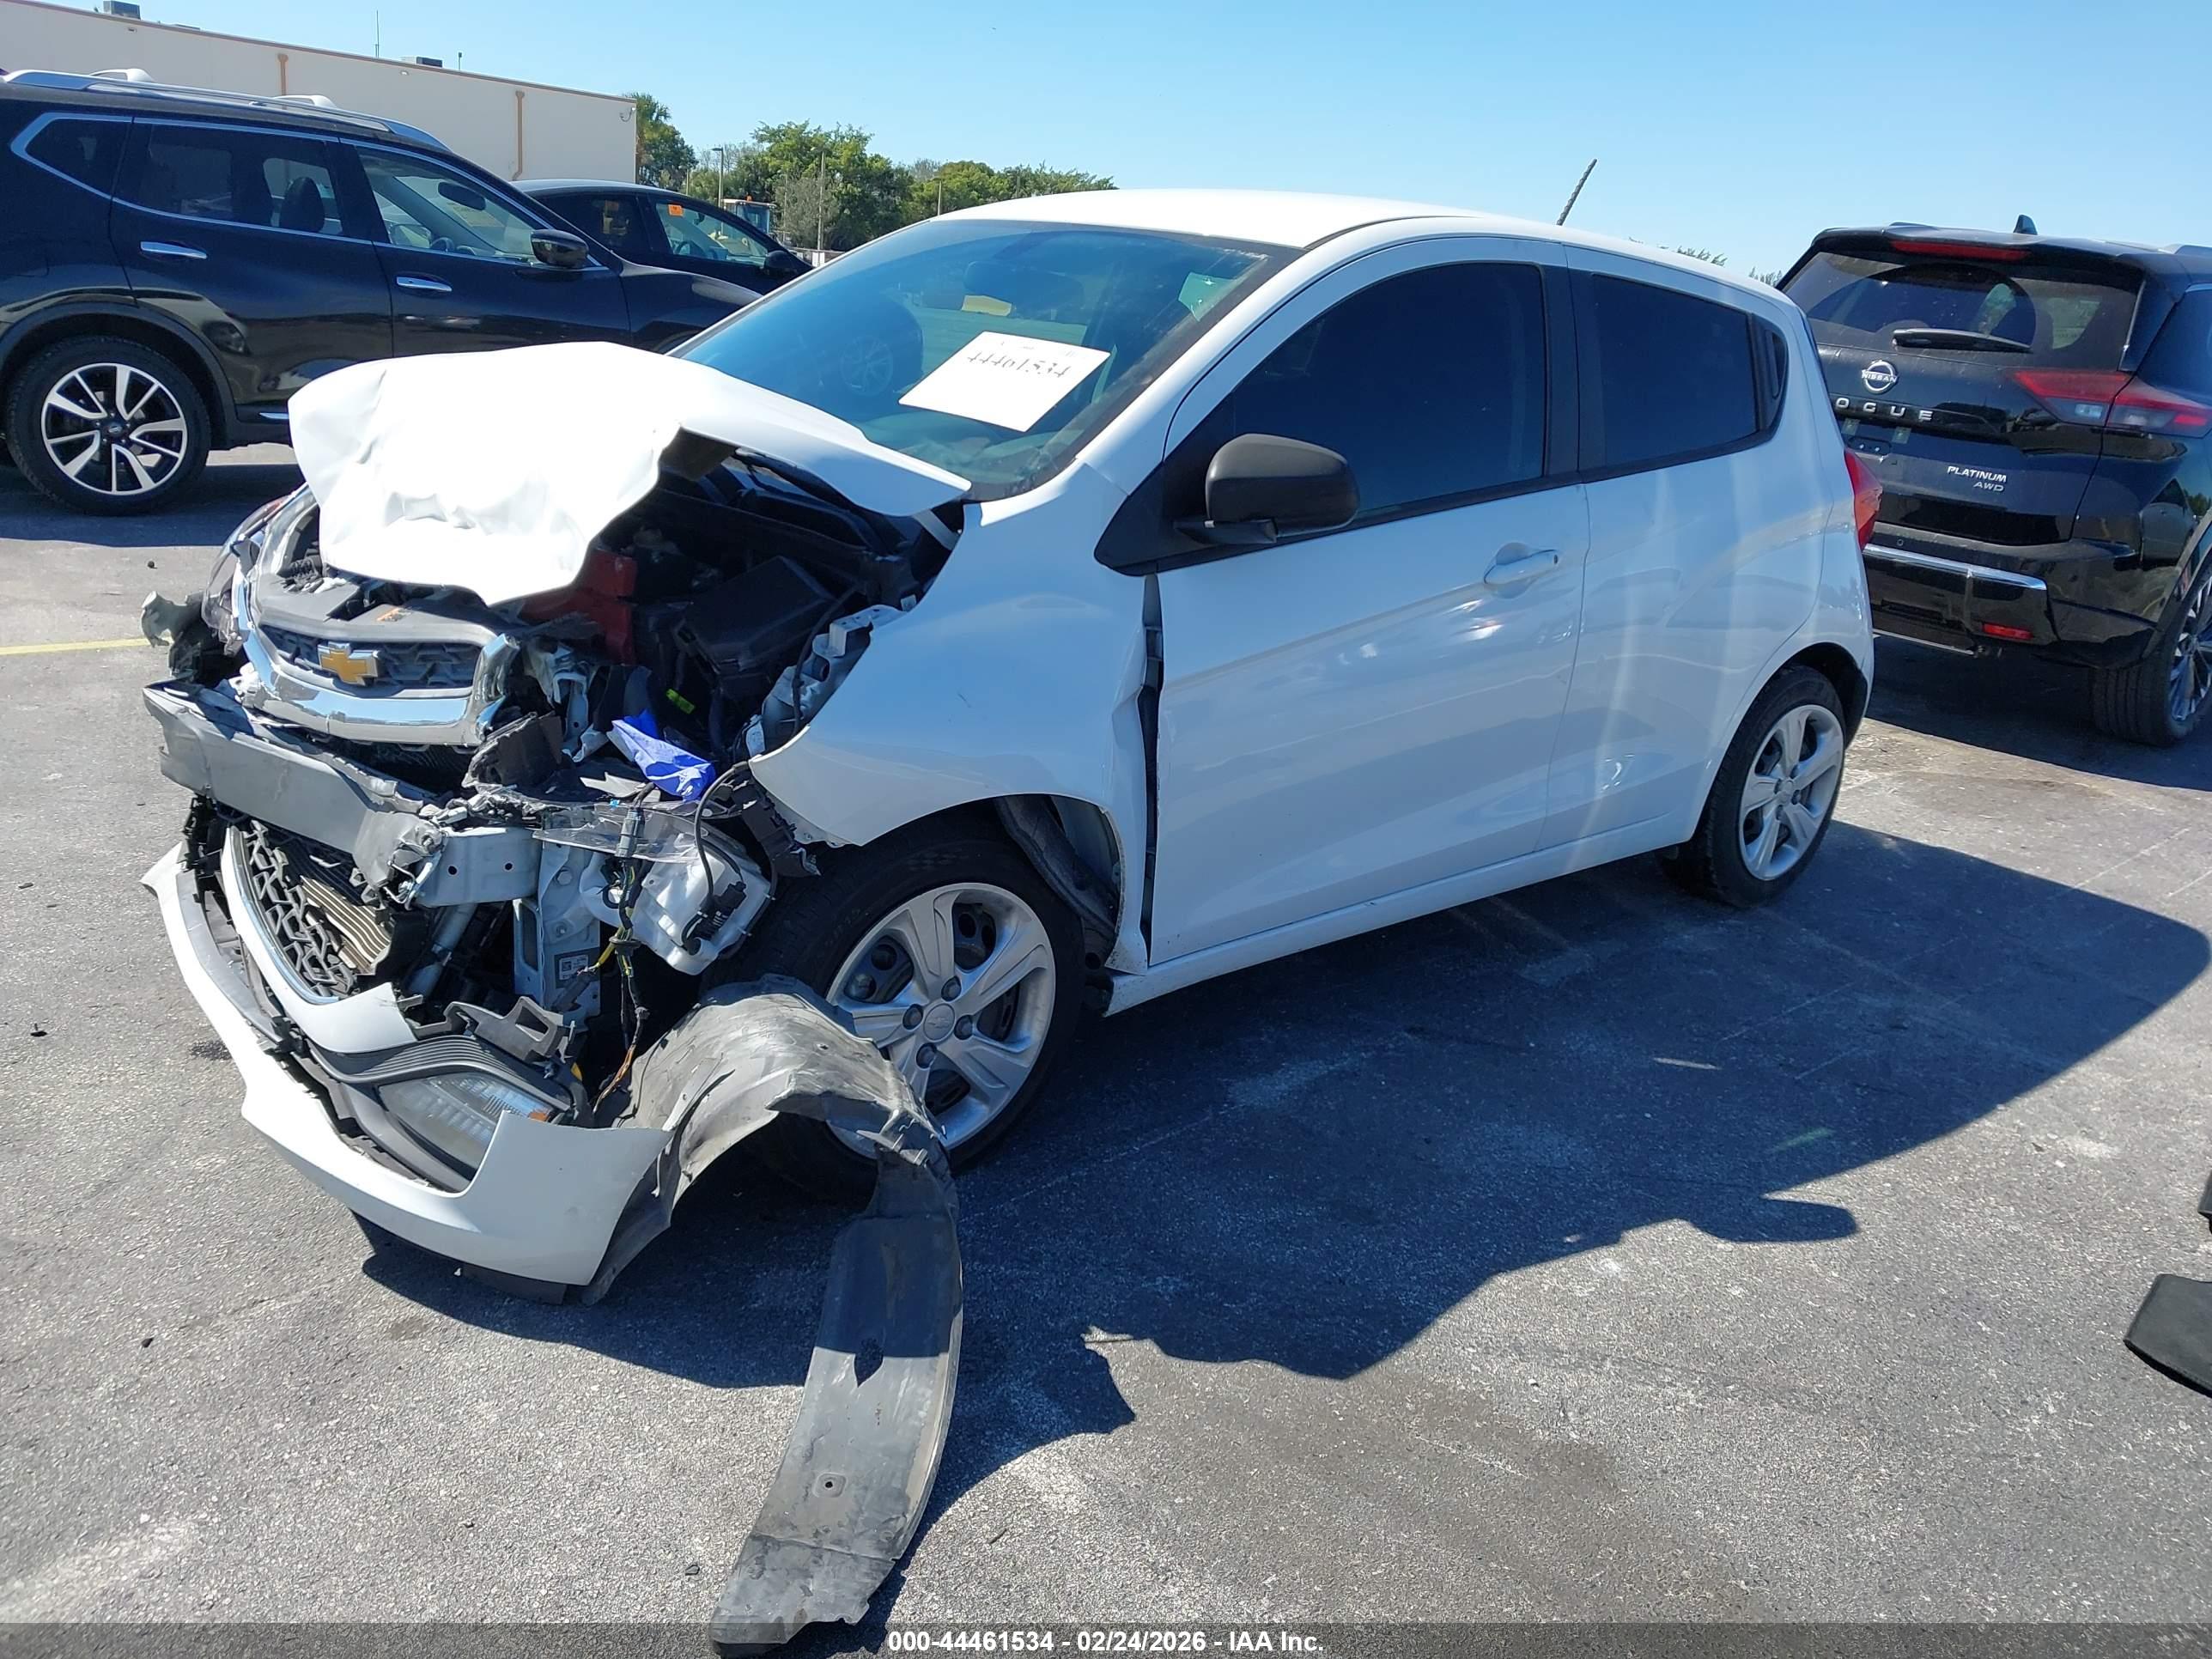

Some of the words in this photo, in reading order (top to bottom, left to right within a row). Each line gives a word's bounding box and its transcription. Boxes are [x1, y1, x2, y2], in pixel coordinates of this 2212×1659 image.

[1861, 369, 1897, 383] NISSAN
[1836, 398, 1934, 422] OGUE
[1947, 465, 2007, 483] PLATINUM
[1973, 481, 2004, 492] AWD
